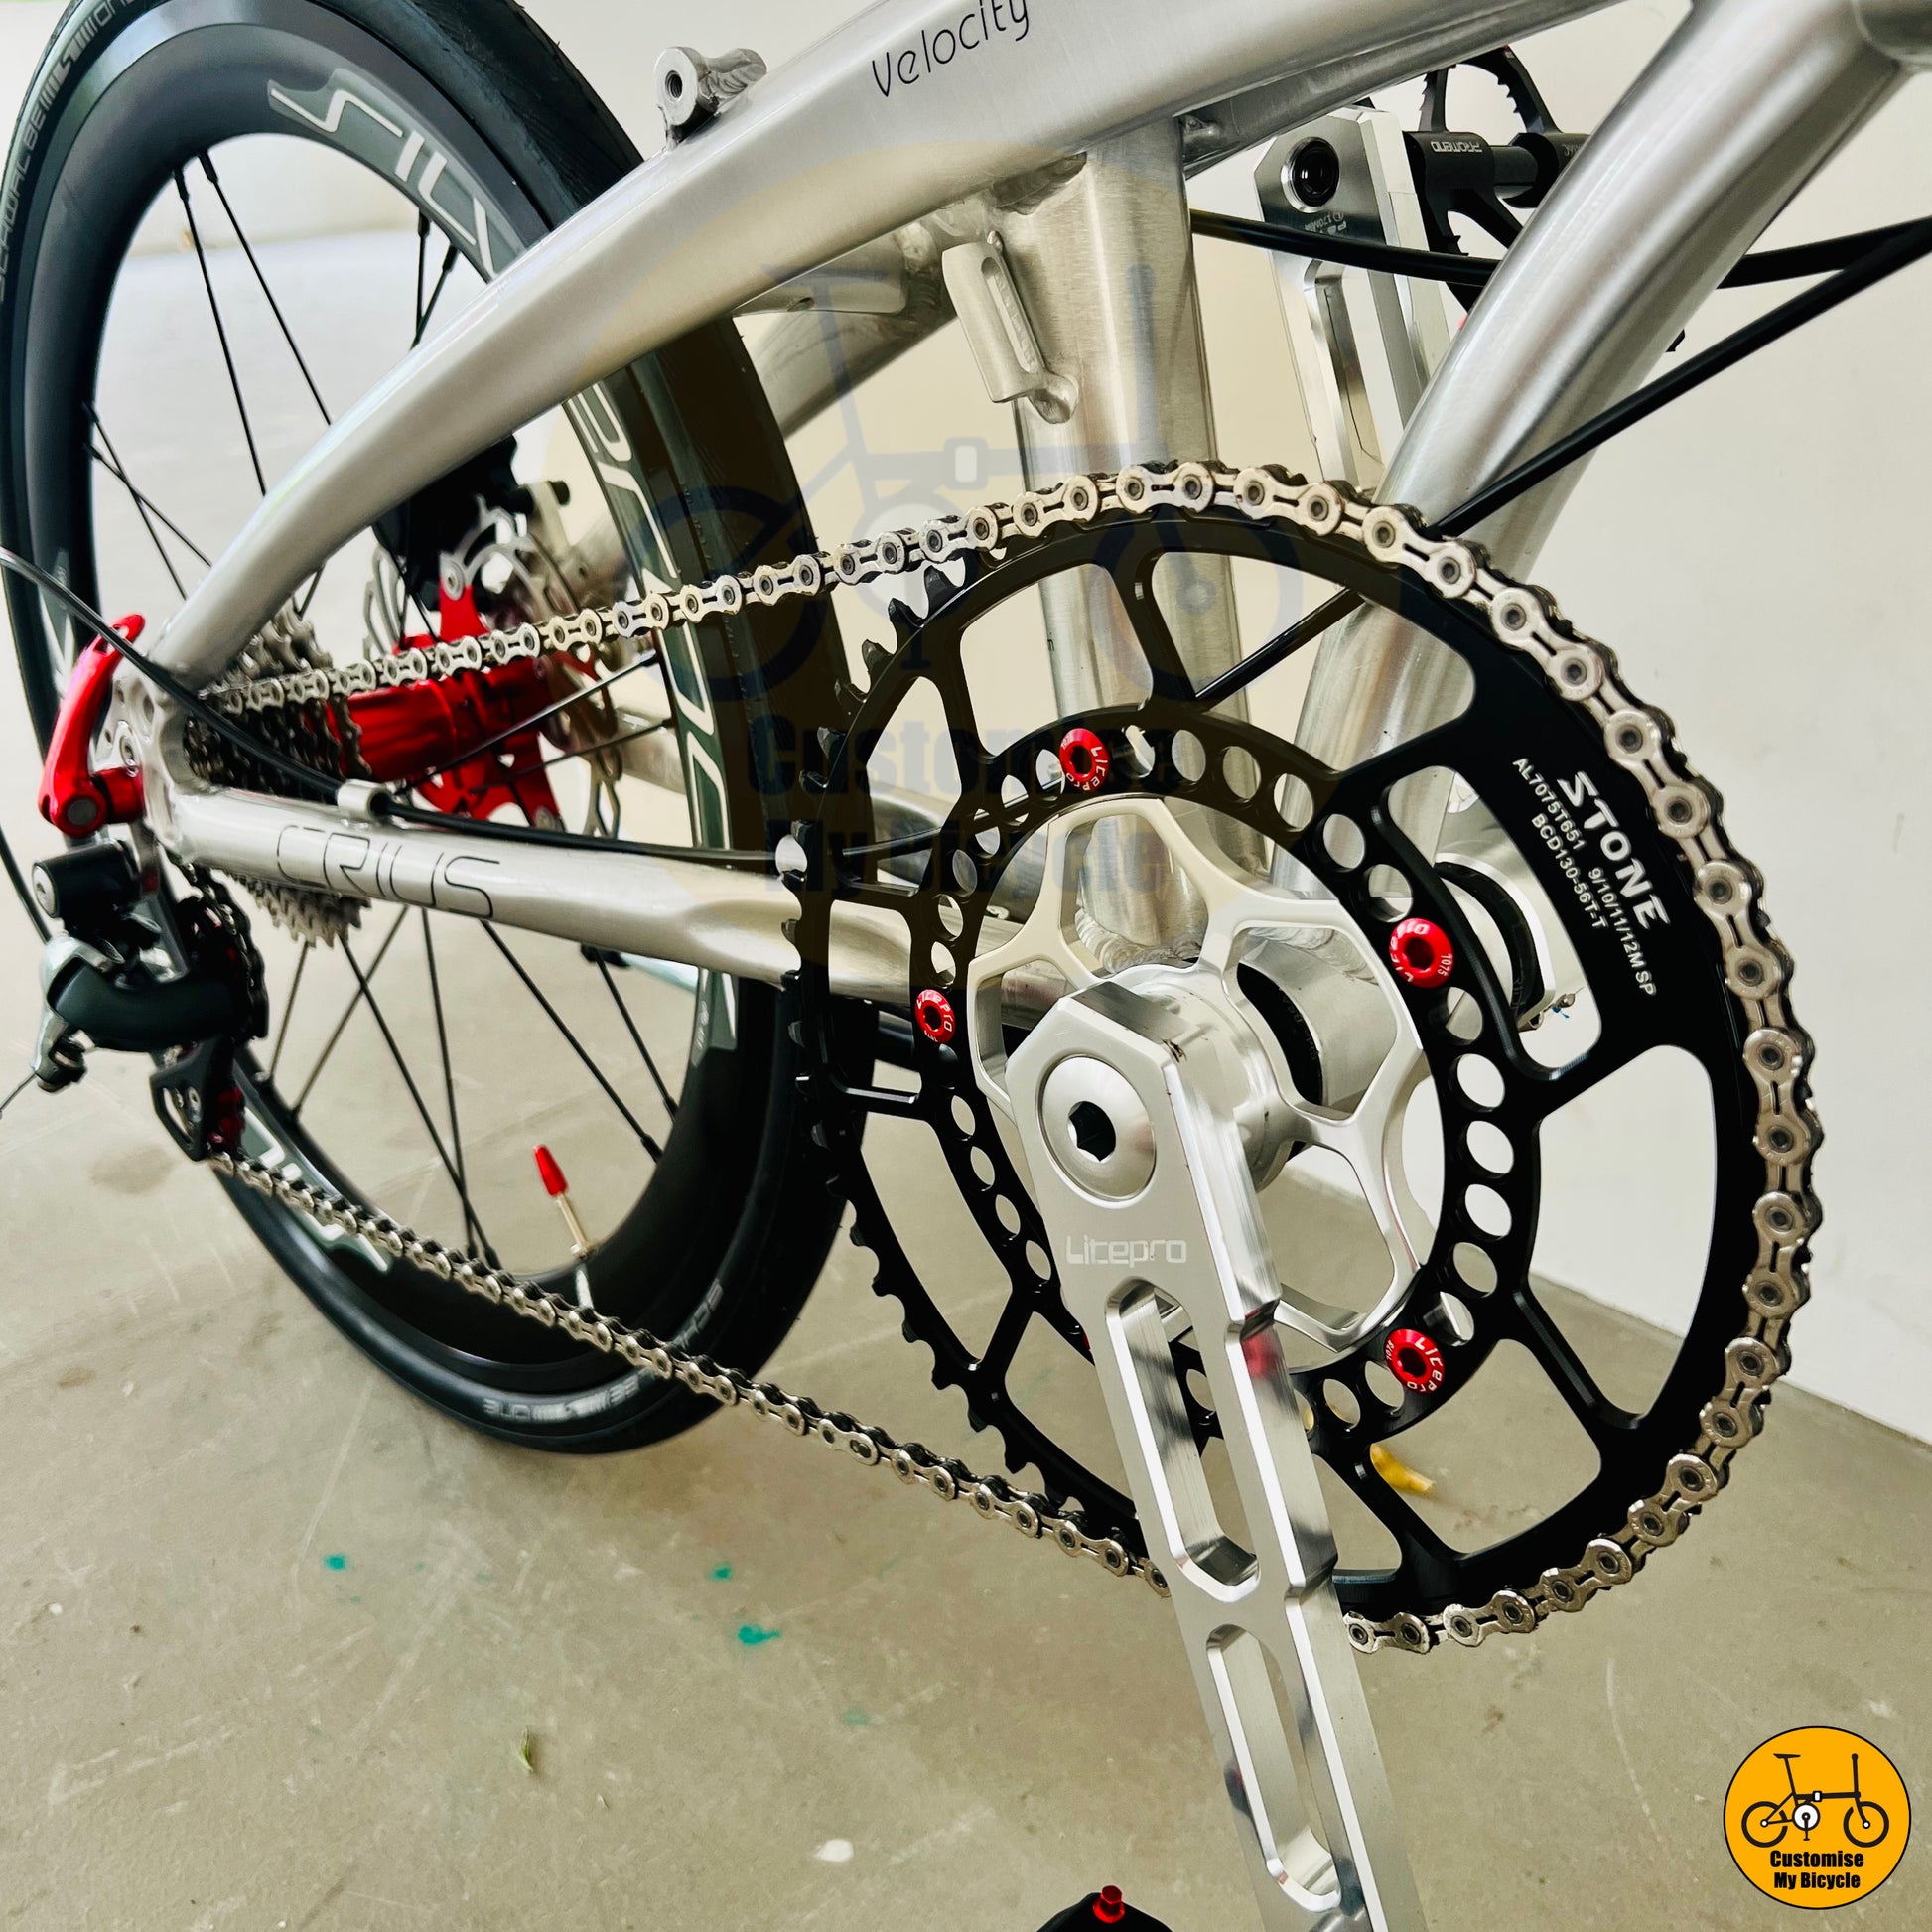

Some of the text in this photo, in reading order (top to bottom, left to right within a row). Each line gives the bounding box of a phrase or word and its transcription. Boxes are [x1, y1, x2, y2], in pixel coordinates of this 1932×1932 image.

[872, 0, 1030, 97] Velocity
[1512, 757, 1587, 850] AL7075T651
[1556, 770, 1671, 929] STONE
[276, 825, 500, 919] CRIUS
[1531, 812, 1609, 929] BCD130-56T-T
[1065, 1234, 1187, 1269] Litepro
